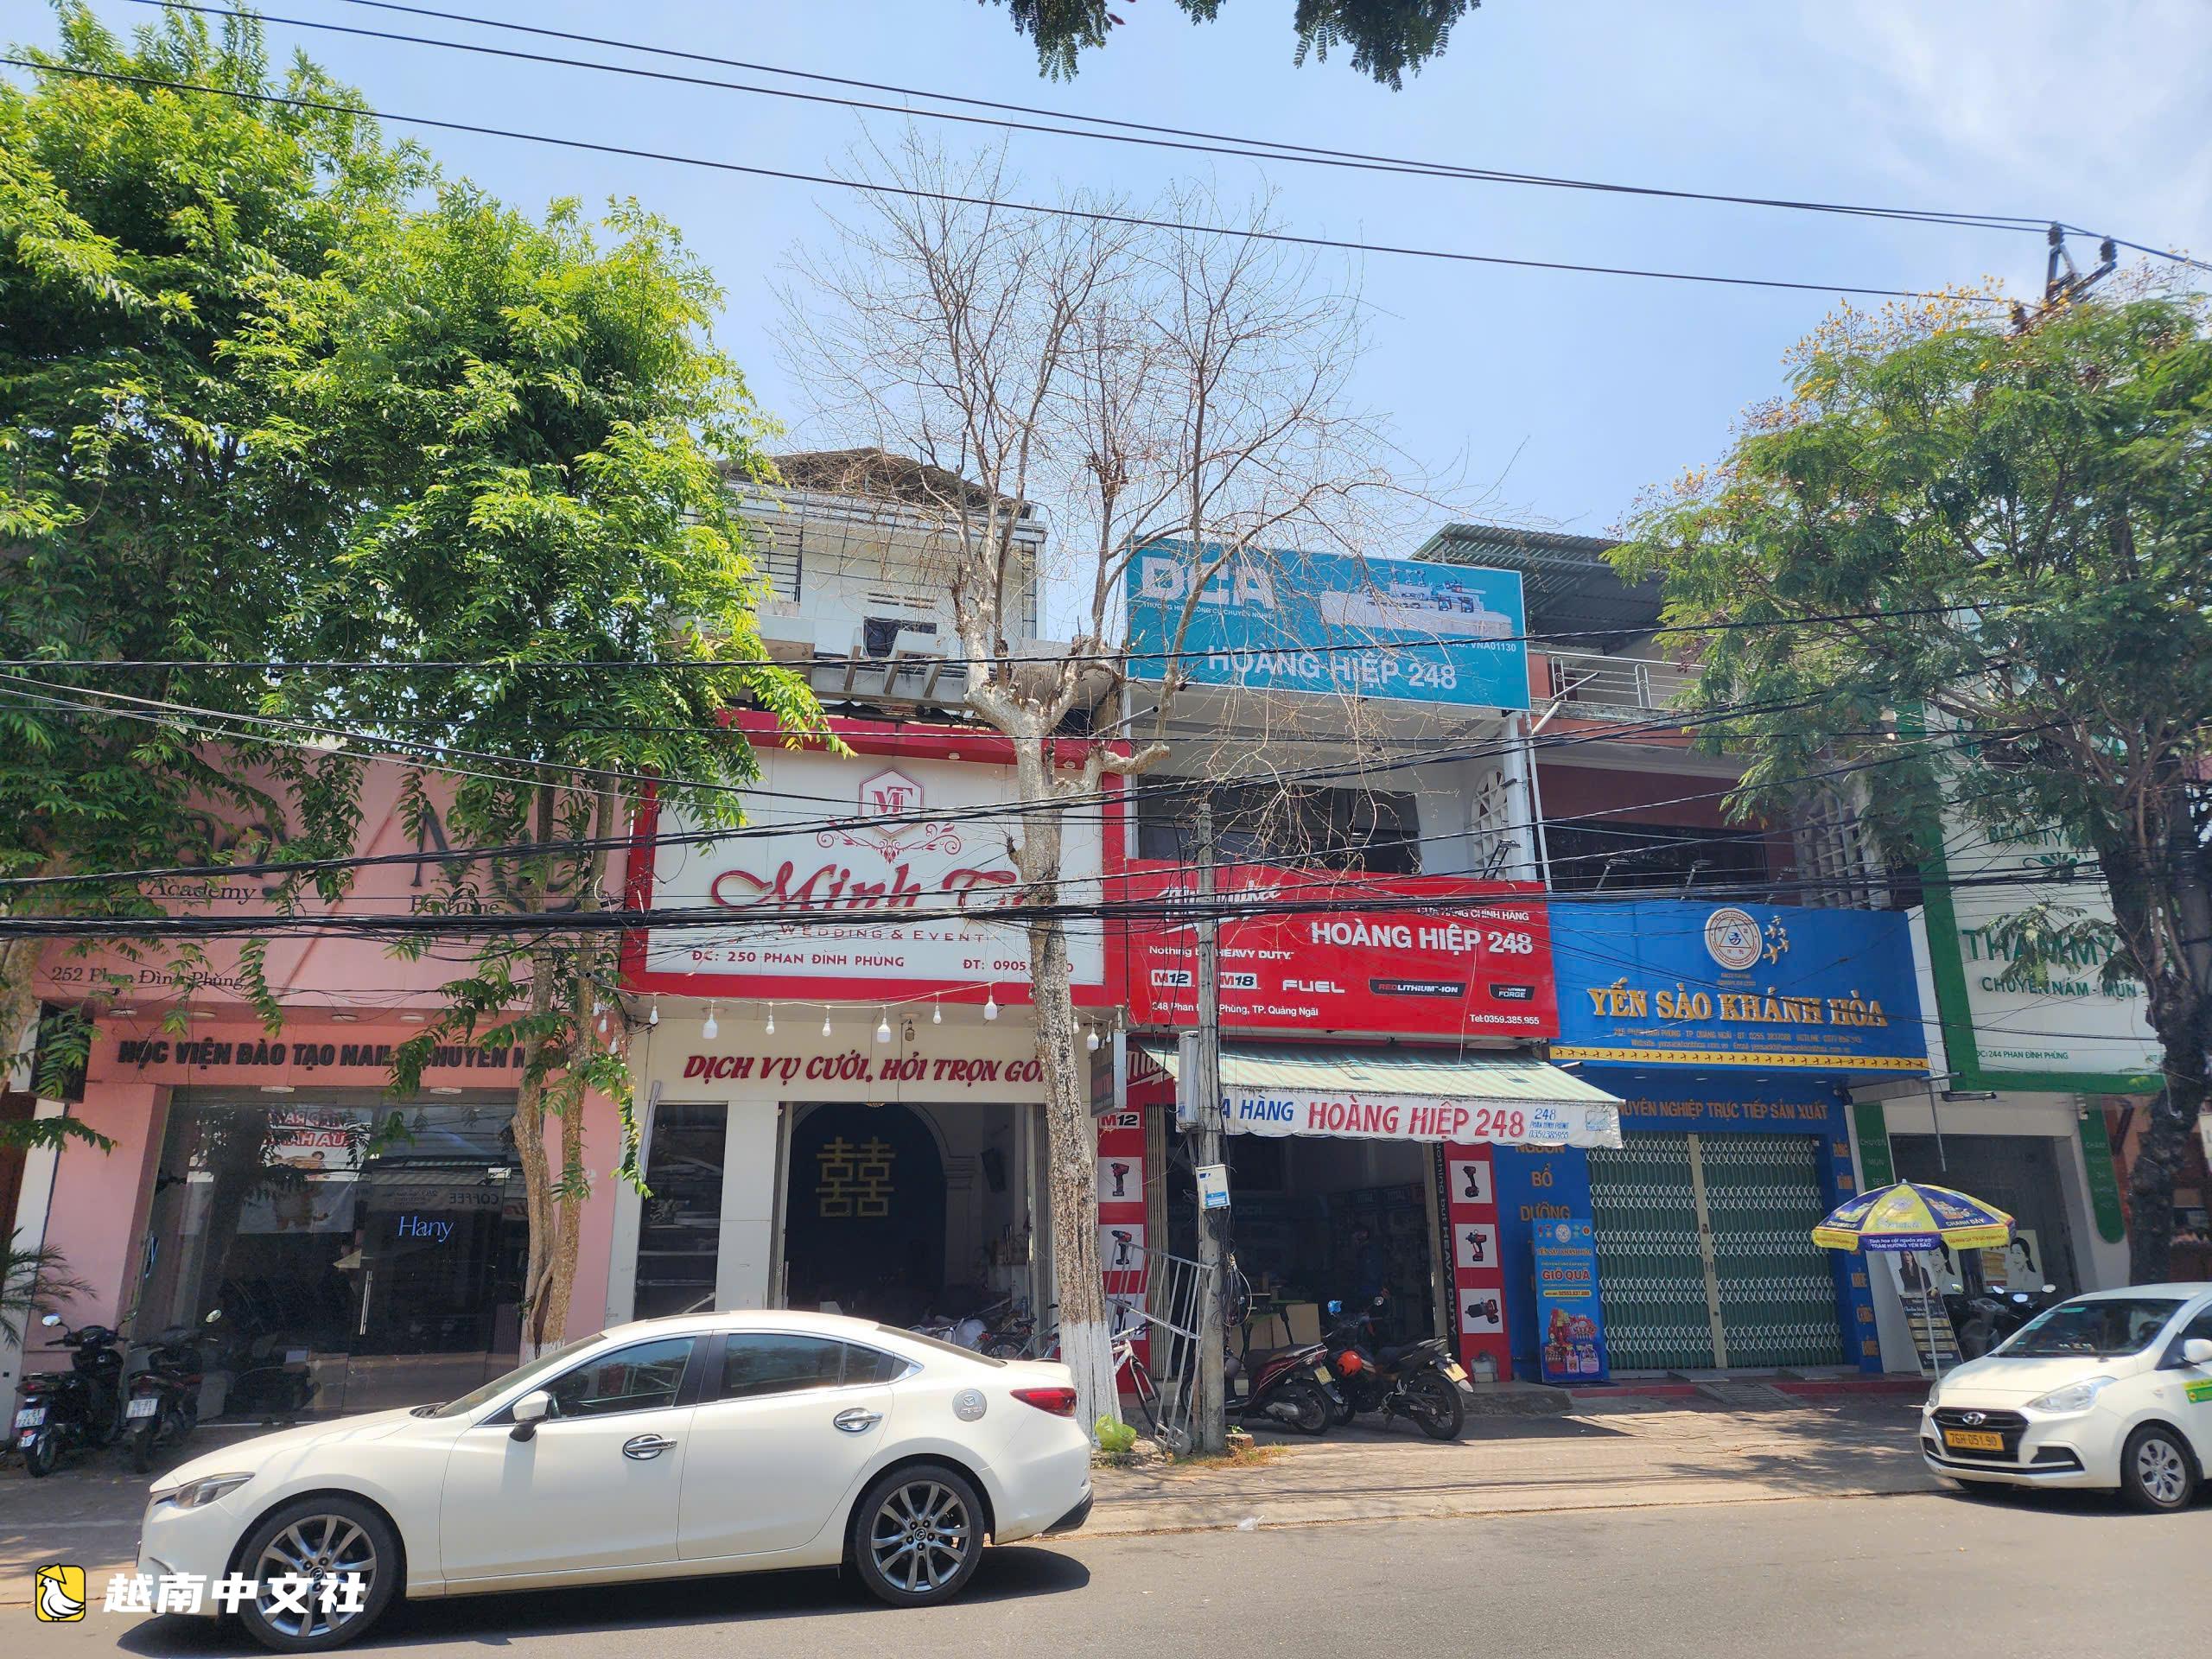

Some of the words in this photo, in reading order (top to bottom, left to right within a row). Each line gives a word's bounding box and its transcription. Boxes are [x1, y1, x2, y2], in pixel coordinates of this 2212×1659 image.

[1408, 663, 1457, 690] 248
[148, 880, 257, 906] Academy
[780, 924, 882, 939] WEDDING
[891, 929, 904, 940] &
[913, 930, 984, 943] EVENT
[1312, 918, 1412, 949] HOÀNG
[1419, 924, 1481, 956] HIỆP
[1487, 931, 1533, 955] 248
[728, 951, 756, 963] 250
[765, 952, 804, 964] PHAN
[963, 959, 985, 970] ĐT:
[994, 960, 1027, 971] 0905
[1149, 945, 1192, 958] Nothing
[1216, 948, 1255, 958] HEAVY
[52, 966, 83, 982] 252
[192, 970, 247, 990] Phùng
[1154, 972, 1189, 984] M12
[1220, 974, 1255, 987] M18
[1283, 979, 1345, 994] FUEL
[1172, 1002, 1193, 1011] Phan
[1253, 1005, 1267, 1014] TP.
[1586, 976, 1648, 1018] YẾN
[1655, 982, 1713, 1020] SÀO
[1718, 986, 1824, 1024] KHÁNH
[1827, 989, 1888, 1027] HÒA
[175, 1037, 232, 1070] VIỆN
[235, 1038, 286, 1066] ĐÀO
[292, 1043, 336, 1071] TẠO
[683, 1055, 754, 1084] DỊCH
[761, 1057, 801, 1086] VỤ
[880, 1052, 928, 1082] HỎI
[933, 1058, 1001, 1088] TRỌN
[1100, 1114, 1139, 1127] M12
[1239, 1095, 1294, 1122] HÀNG
[1307, 1094, 1399, 1134] HOÀNG
[1408, 1101, 1469, 1140] HIỆP
[1474, 1108, 1524, 1138] 248
[1534, 1108, 1556, 1121] 248
[1659, 1098, 1703, 1121] NGHIỆP
[398, 1216, 454, 1243] Hany
